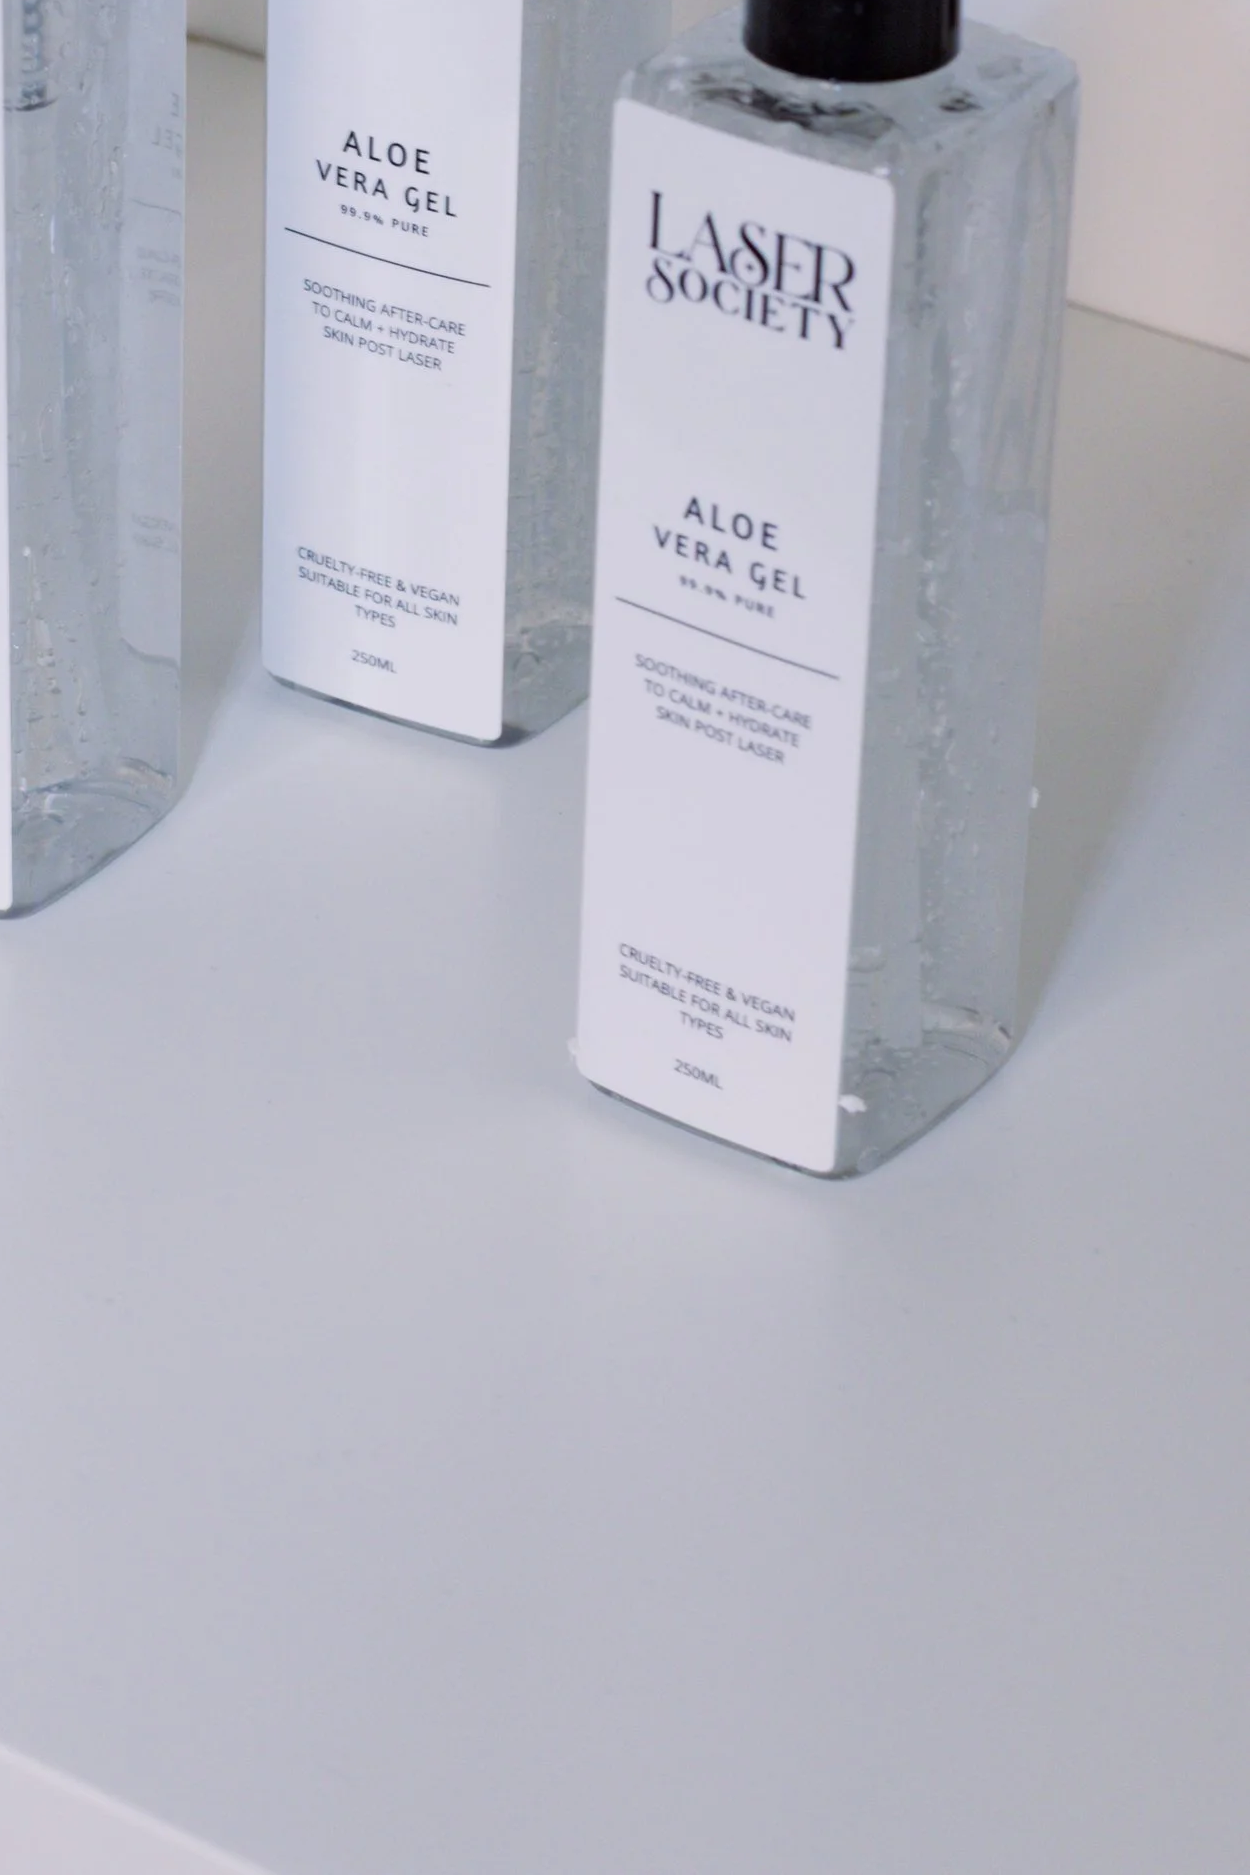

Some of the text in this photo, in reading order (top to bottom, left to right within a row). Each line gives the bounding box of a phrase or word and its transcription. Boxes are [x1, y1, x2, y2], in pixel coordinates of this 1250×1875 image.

[343, 131, 430, 174] ALOE
[316, 160, 457, 217] VERA GEL
[341, 204, 428, 237] 99.9% PURE
[650, 191, 855, 313] LASER
[304, 279, 465, 336] SOOTHING AFTER-CARE
[312, 301, 454, 354] TO CALM + HYDRATE
[646, 258, 852, 350] SOCIETY
[323, 326, 442, 370] SKIN POST LASER
[683, 496, 777, 551] ALOE
[298, 546, 459, 607] CRUELTY-FREE & VEGAN
[654, 526, 805, 599] VERA GEL
[299, 566, 457, 626] SUITABLE FOR ALL SKIN
[355, 605, 395, 628] TYPES
[679, 575, 774, 618] 99.9% PURE
[352, 649, 396, 673] 250ML
[635, 653, 811, 730] SOOTHING AFTER-CARE
[644, 678, 799, 748] TO CALM + HYDRATE
[656, 706, 785, 764] SKIN POST LASER
[619, 943, 795, 1022] CRUELTY-FREE & VEGAN
[620, 964, 792, 1042] SUITABLE FOR ALL SKIN
[680, 1011, 723, 1039] TYPES
[674, 1059, 723, 1090] 250ML
